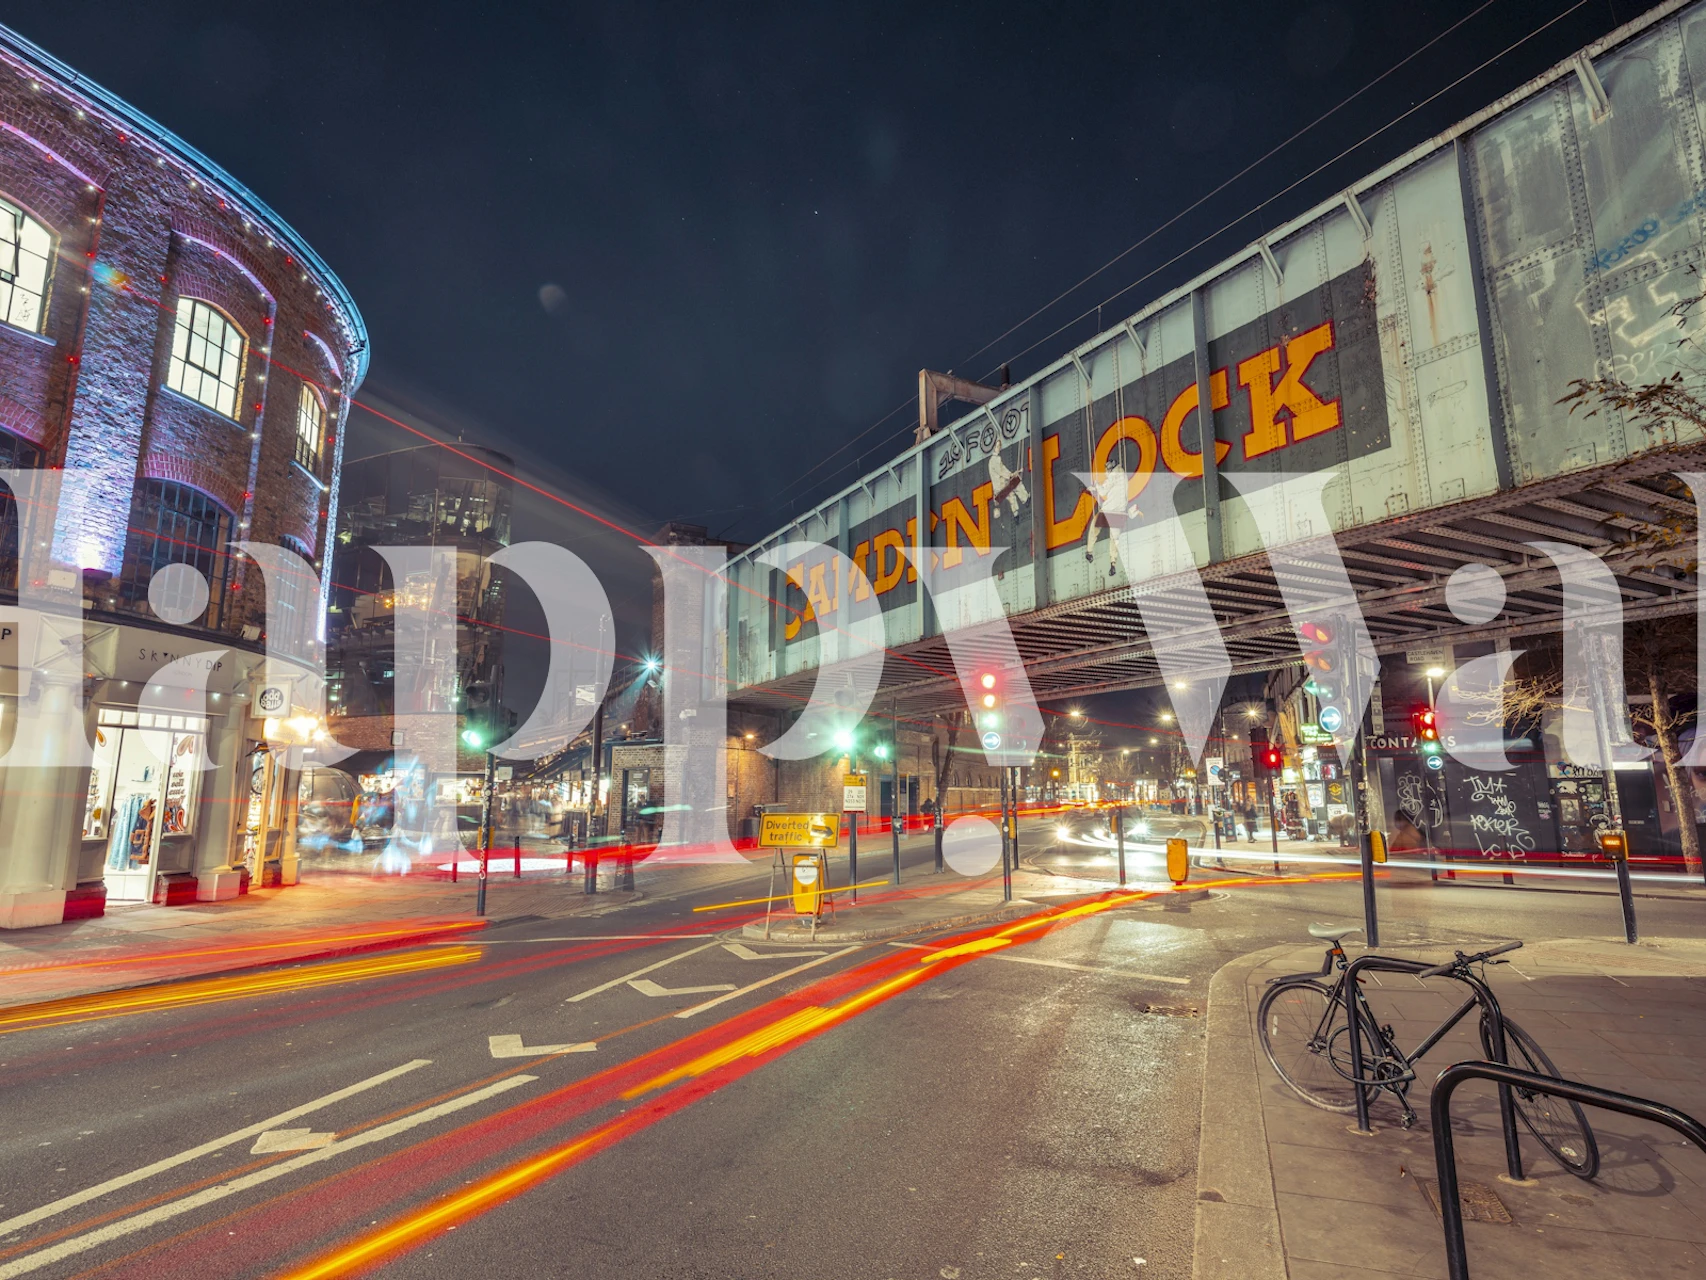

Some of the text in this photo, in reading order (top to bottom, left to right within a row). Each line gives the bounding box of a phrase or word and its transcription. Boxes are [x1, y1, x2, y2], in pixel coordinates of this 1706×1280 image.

[1028, 320, 1344, 551] LOCK
[1370, 736, 1456, 749] CONTAS
[766, 820, 809, 830] Diverted
[769, 832, 803, 841] traffic
